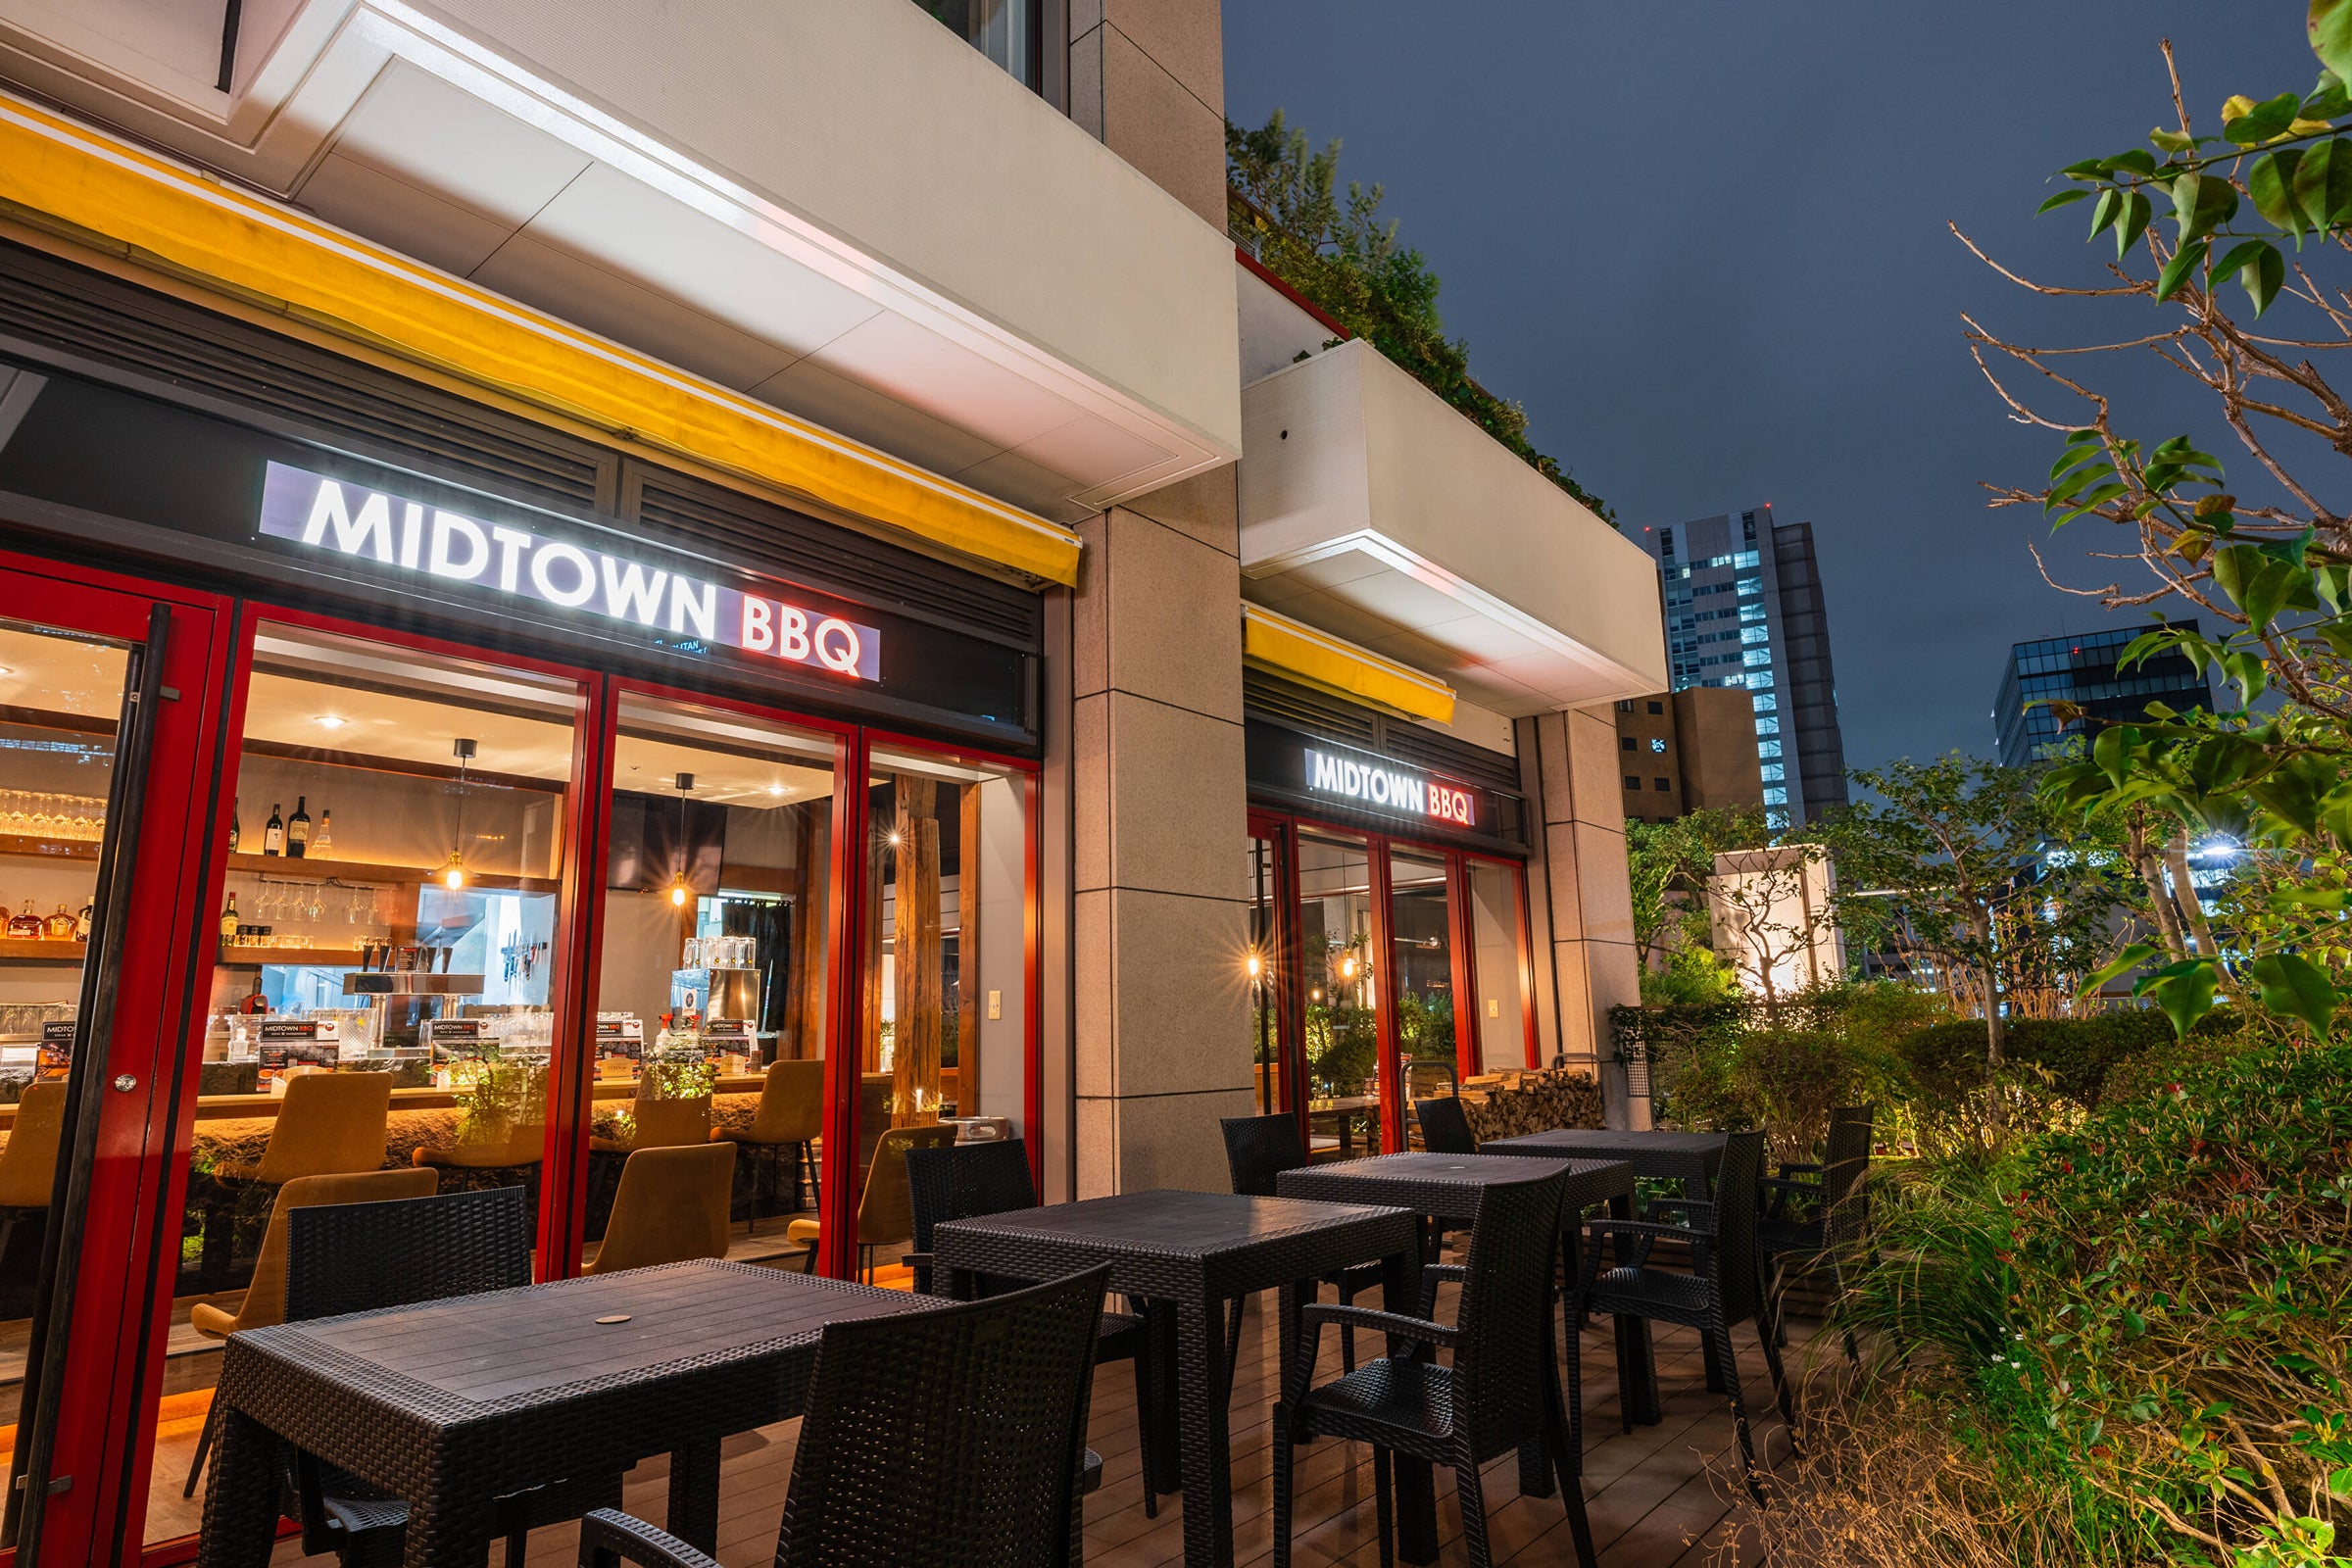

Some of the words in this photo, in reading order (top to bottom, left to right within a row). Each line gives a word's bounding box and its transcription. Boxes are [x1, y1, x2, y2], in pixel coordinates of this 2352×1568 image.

[302, 479, 717, 641] MIDTOWN
[742, 594, 861, 678] BBQ
[1314, 754, 1424, 812] MIDTOWN
[1429, 784, 1469, 825] BBQ
